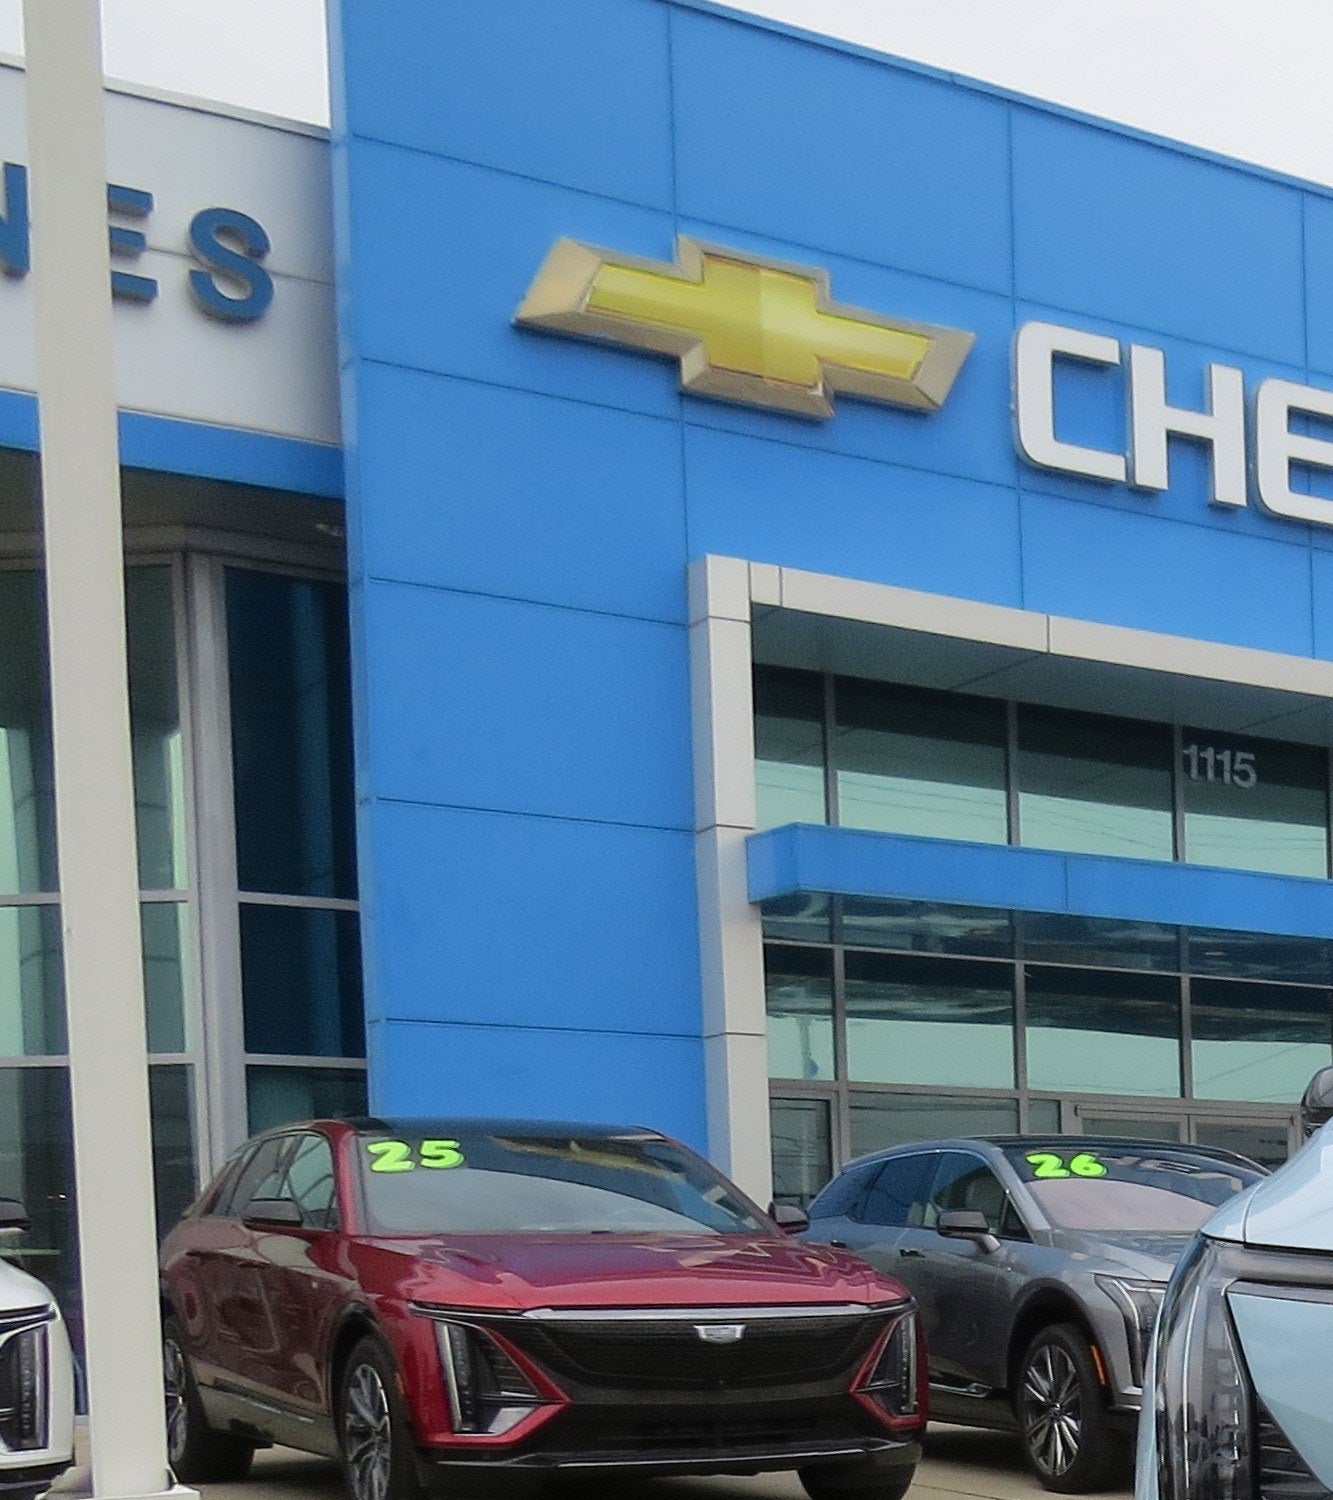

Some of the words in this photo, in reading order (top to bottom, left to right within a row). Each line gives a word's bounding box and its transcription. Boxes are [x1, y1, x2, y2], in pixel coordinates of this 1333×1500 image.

[1182, 744, 1257, 788] 1115
[367, 1139, 466, 1173] 25
[1025, 1152, 1108, 1178] 26
